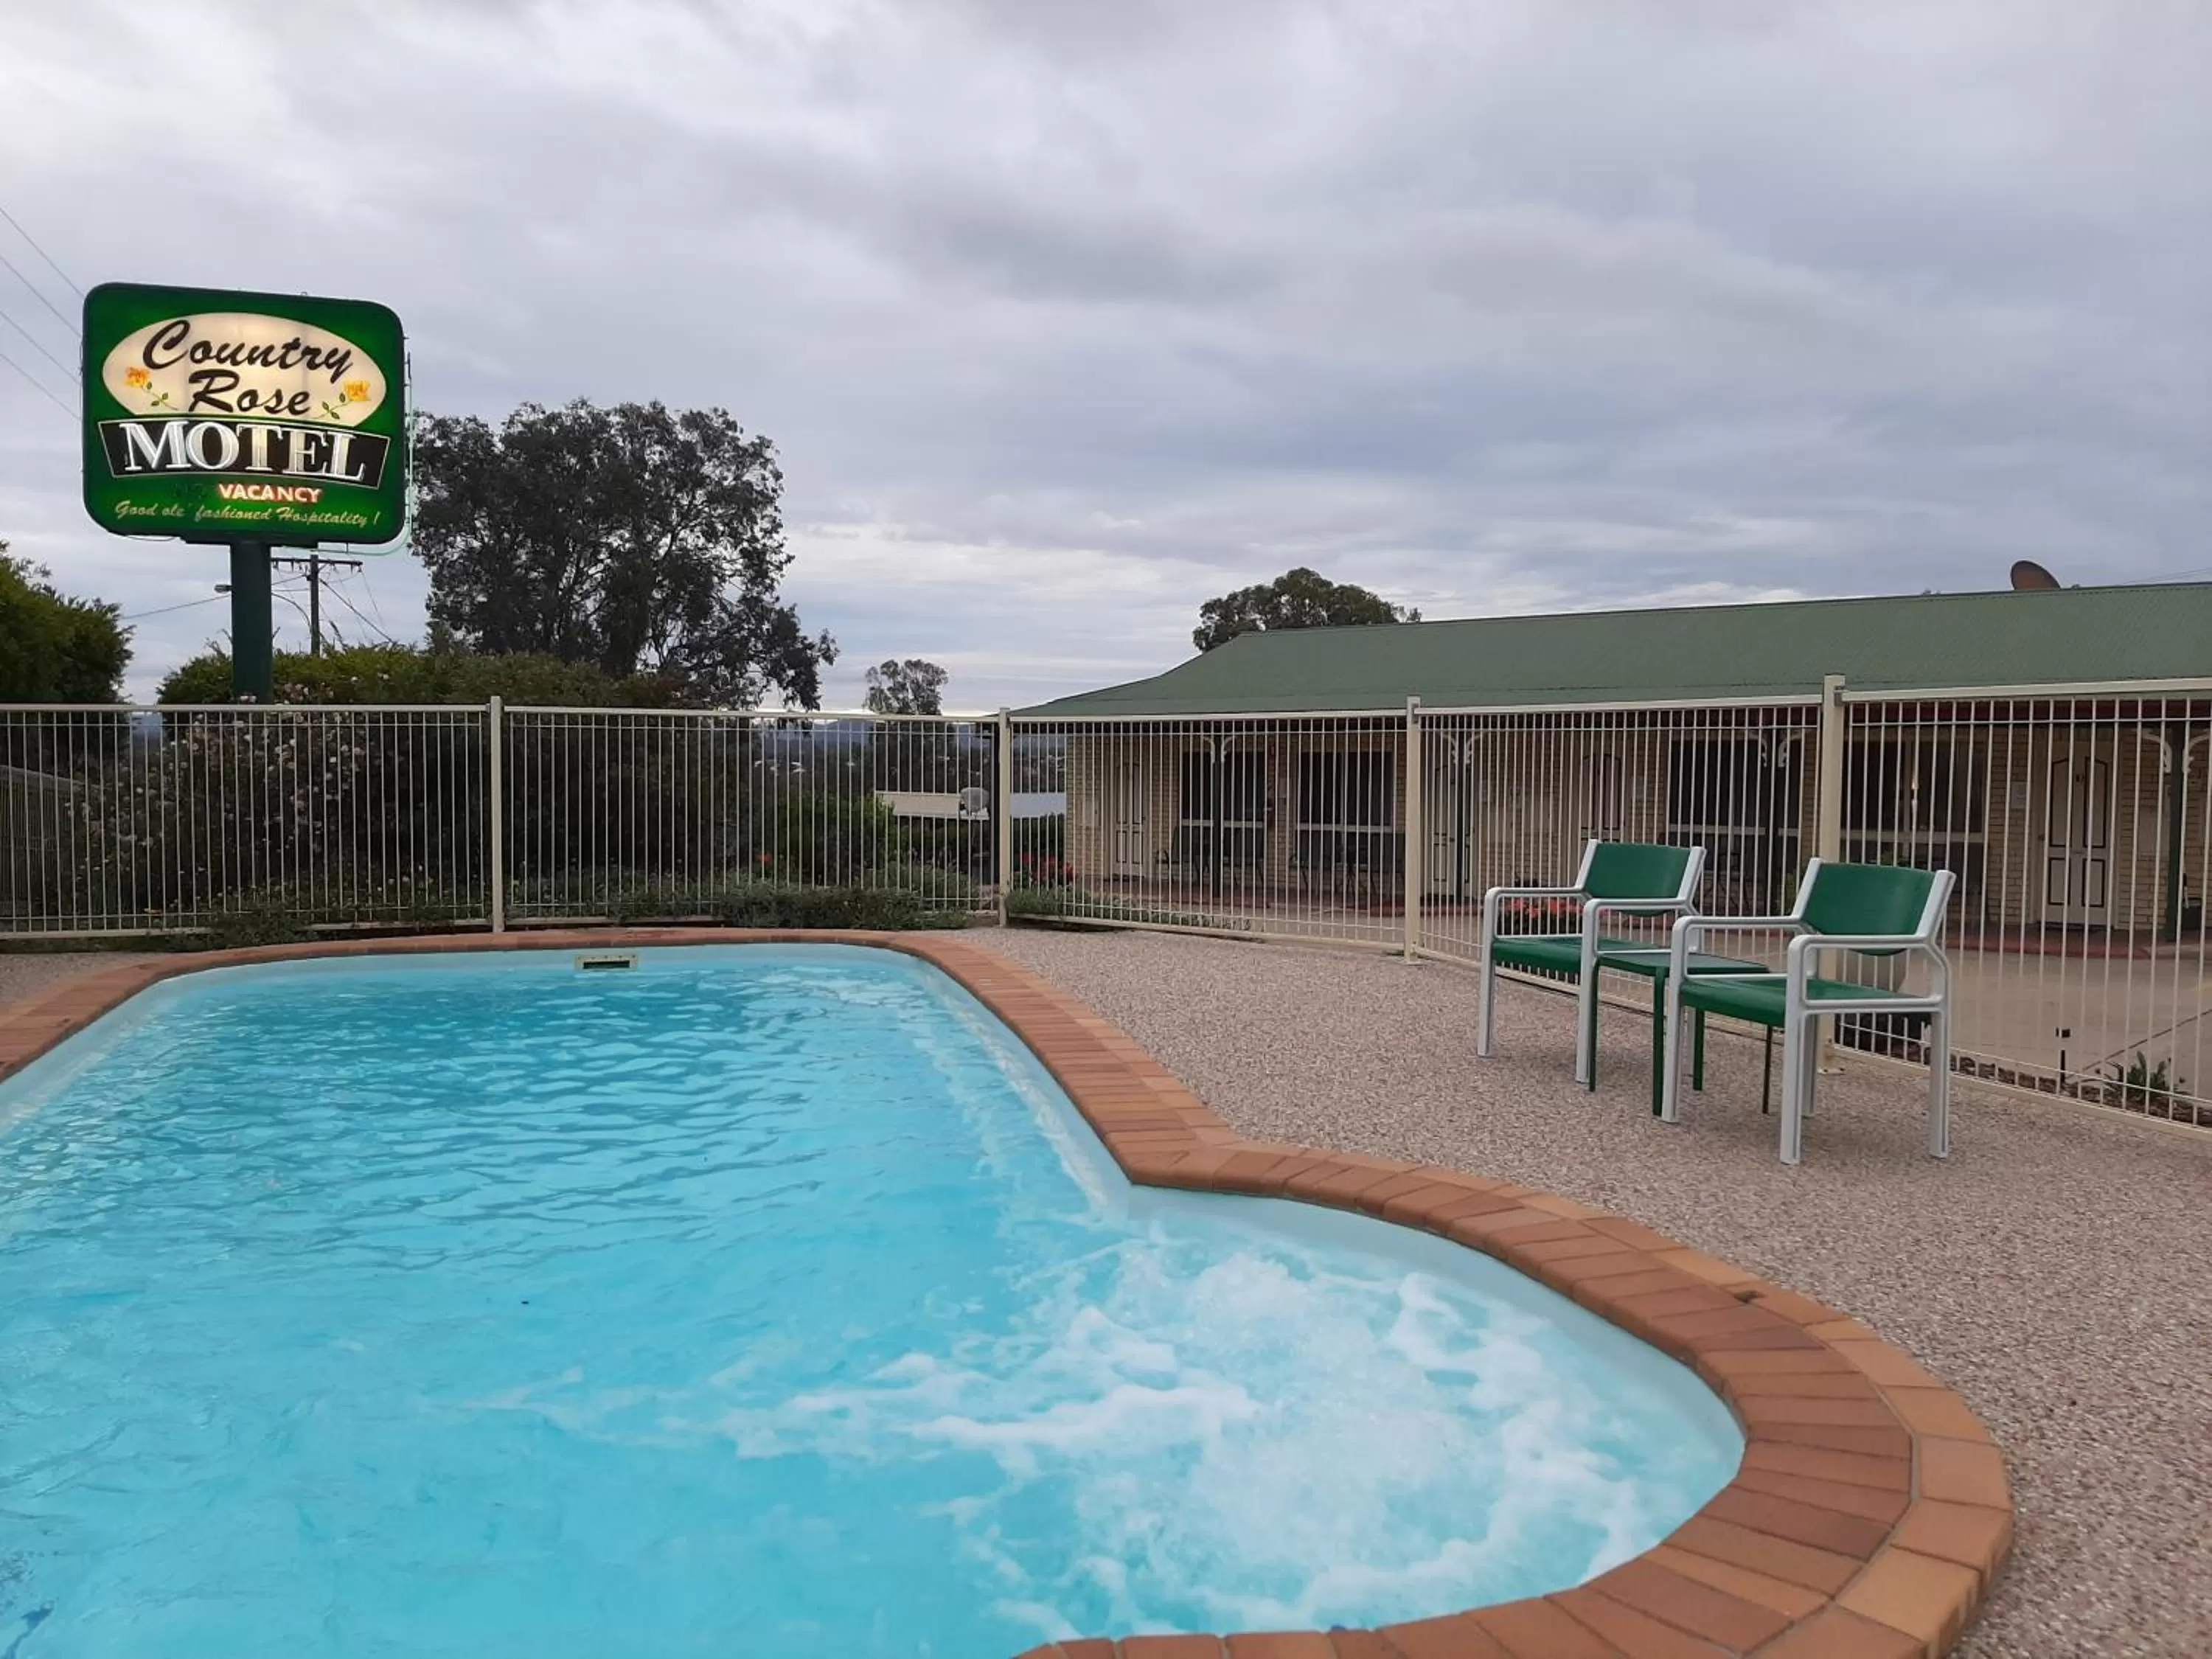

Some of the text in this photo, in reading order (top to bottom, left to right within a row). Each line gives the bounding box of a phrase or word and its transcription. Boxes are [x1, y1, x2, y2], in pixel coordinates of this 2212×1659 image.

[143, 319, 353, 383] Country
[188, 369, 311, 414] Rose
[119, 421, 366, 481] MOTEL
[114, 499, 159, 520] Good
[194, 504, 272, 523] fashioned
[218, 483, 322, 504] VACANCY
